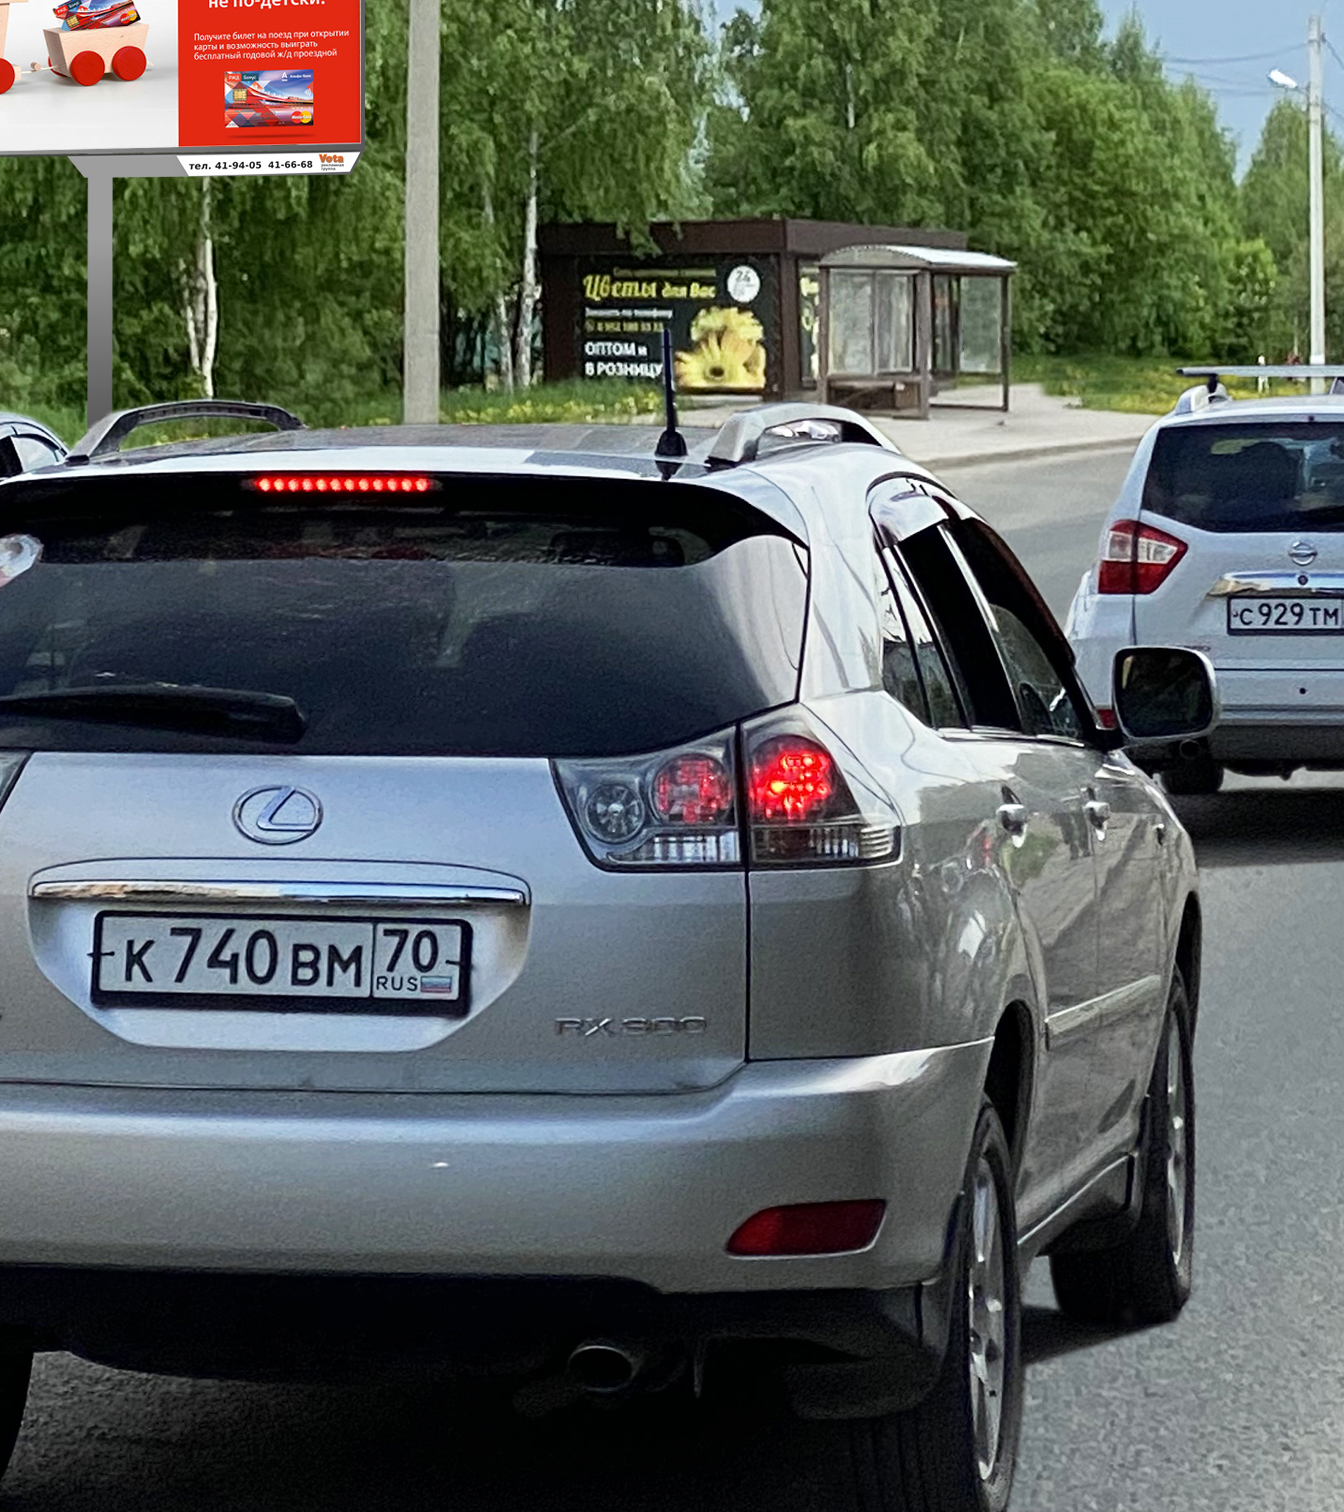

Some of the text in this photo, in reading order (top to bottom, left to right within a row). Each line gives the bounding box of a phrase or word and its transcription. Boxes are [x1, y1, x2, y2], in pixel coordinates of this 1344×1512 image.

[194, 32, 232, 42] Получите
[232, 31, 255, 40] билет
[268, 31, 292, 40] поезд
[293, 31, 309, 40] при
[310, 30, 350, 39] открытии
[194, 43, 218, 52] карты
[226, 42, 279, 50] возможность
[280, 41, 318, 50] выиграть
[194, 48, 337, 60] бесплатный годовой ж/д проездной
[215, 161, 262, 170] 41-94-05
[268, 160, 313, 169] 41-66-68
[583, 274, 657, 301] Цветы
[585, 341, 636, 356] ОПТОМ
[585, 361, 663, 378] В РОЗНИЦУ
[375, 975, 419, 992] RUS
